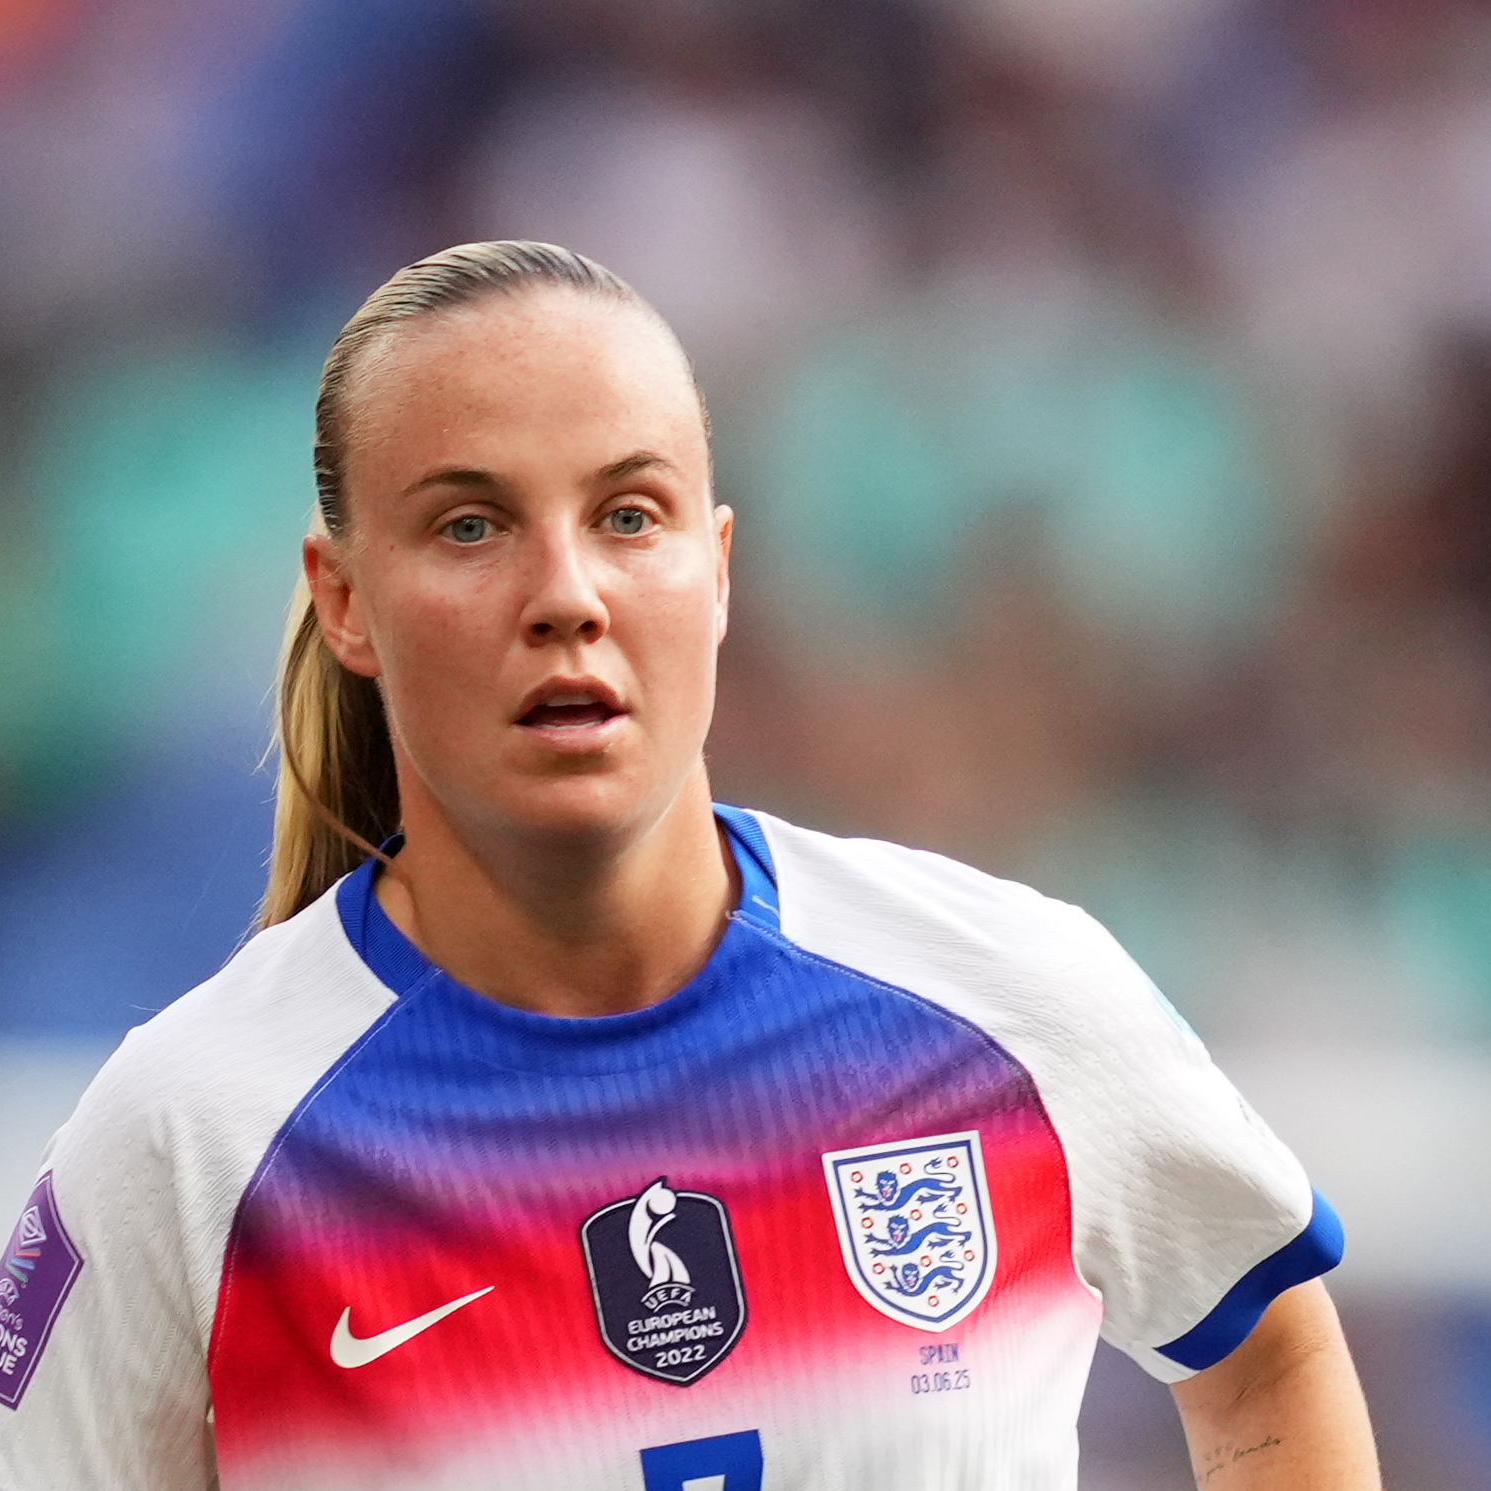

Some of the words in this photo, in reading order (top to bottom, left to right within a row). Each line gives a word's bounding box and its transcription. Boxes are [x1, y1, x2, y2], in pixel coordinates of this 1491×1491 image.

[644, 1288, 692, 1310] UEFA
[628, 1306, 716, 1334] EUROPEAN
[627, 1321, 724, 1351] CHAMPIONS
[655, 1344, 707, 1367] 2022
[919, 1343, 959, 1365] SPAIN
[911, 1369, 971, 1394] 03.06.25
